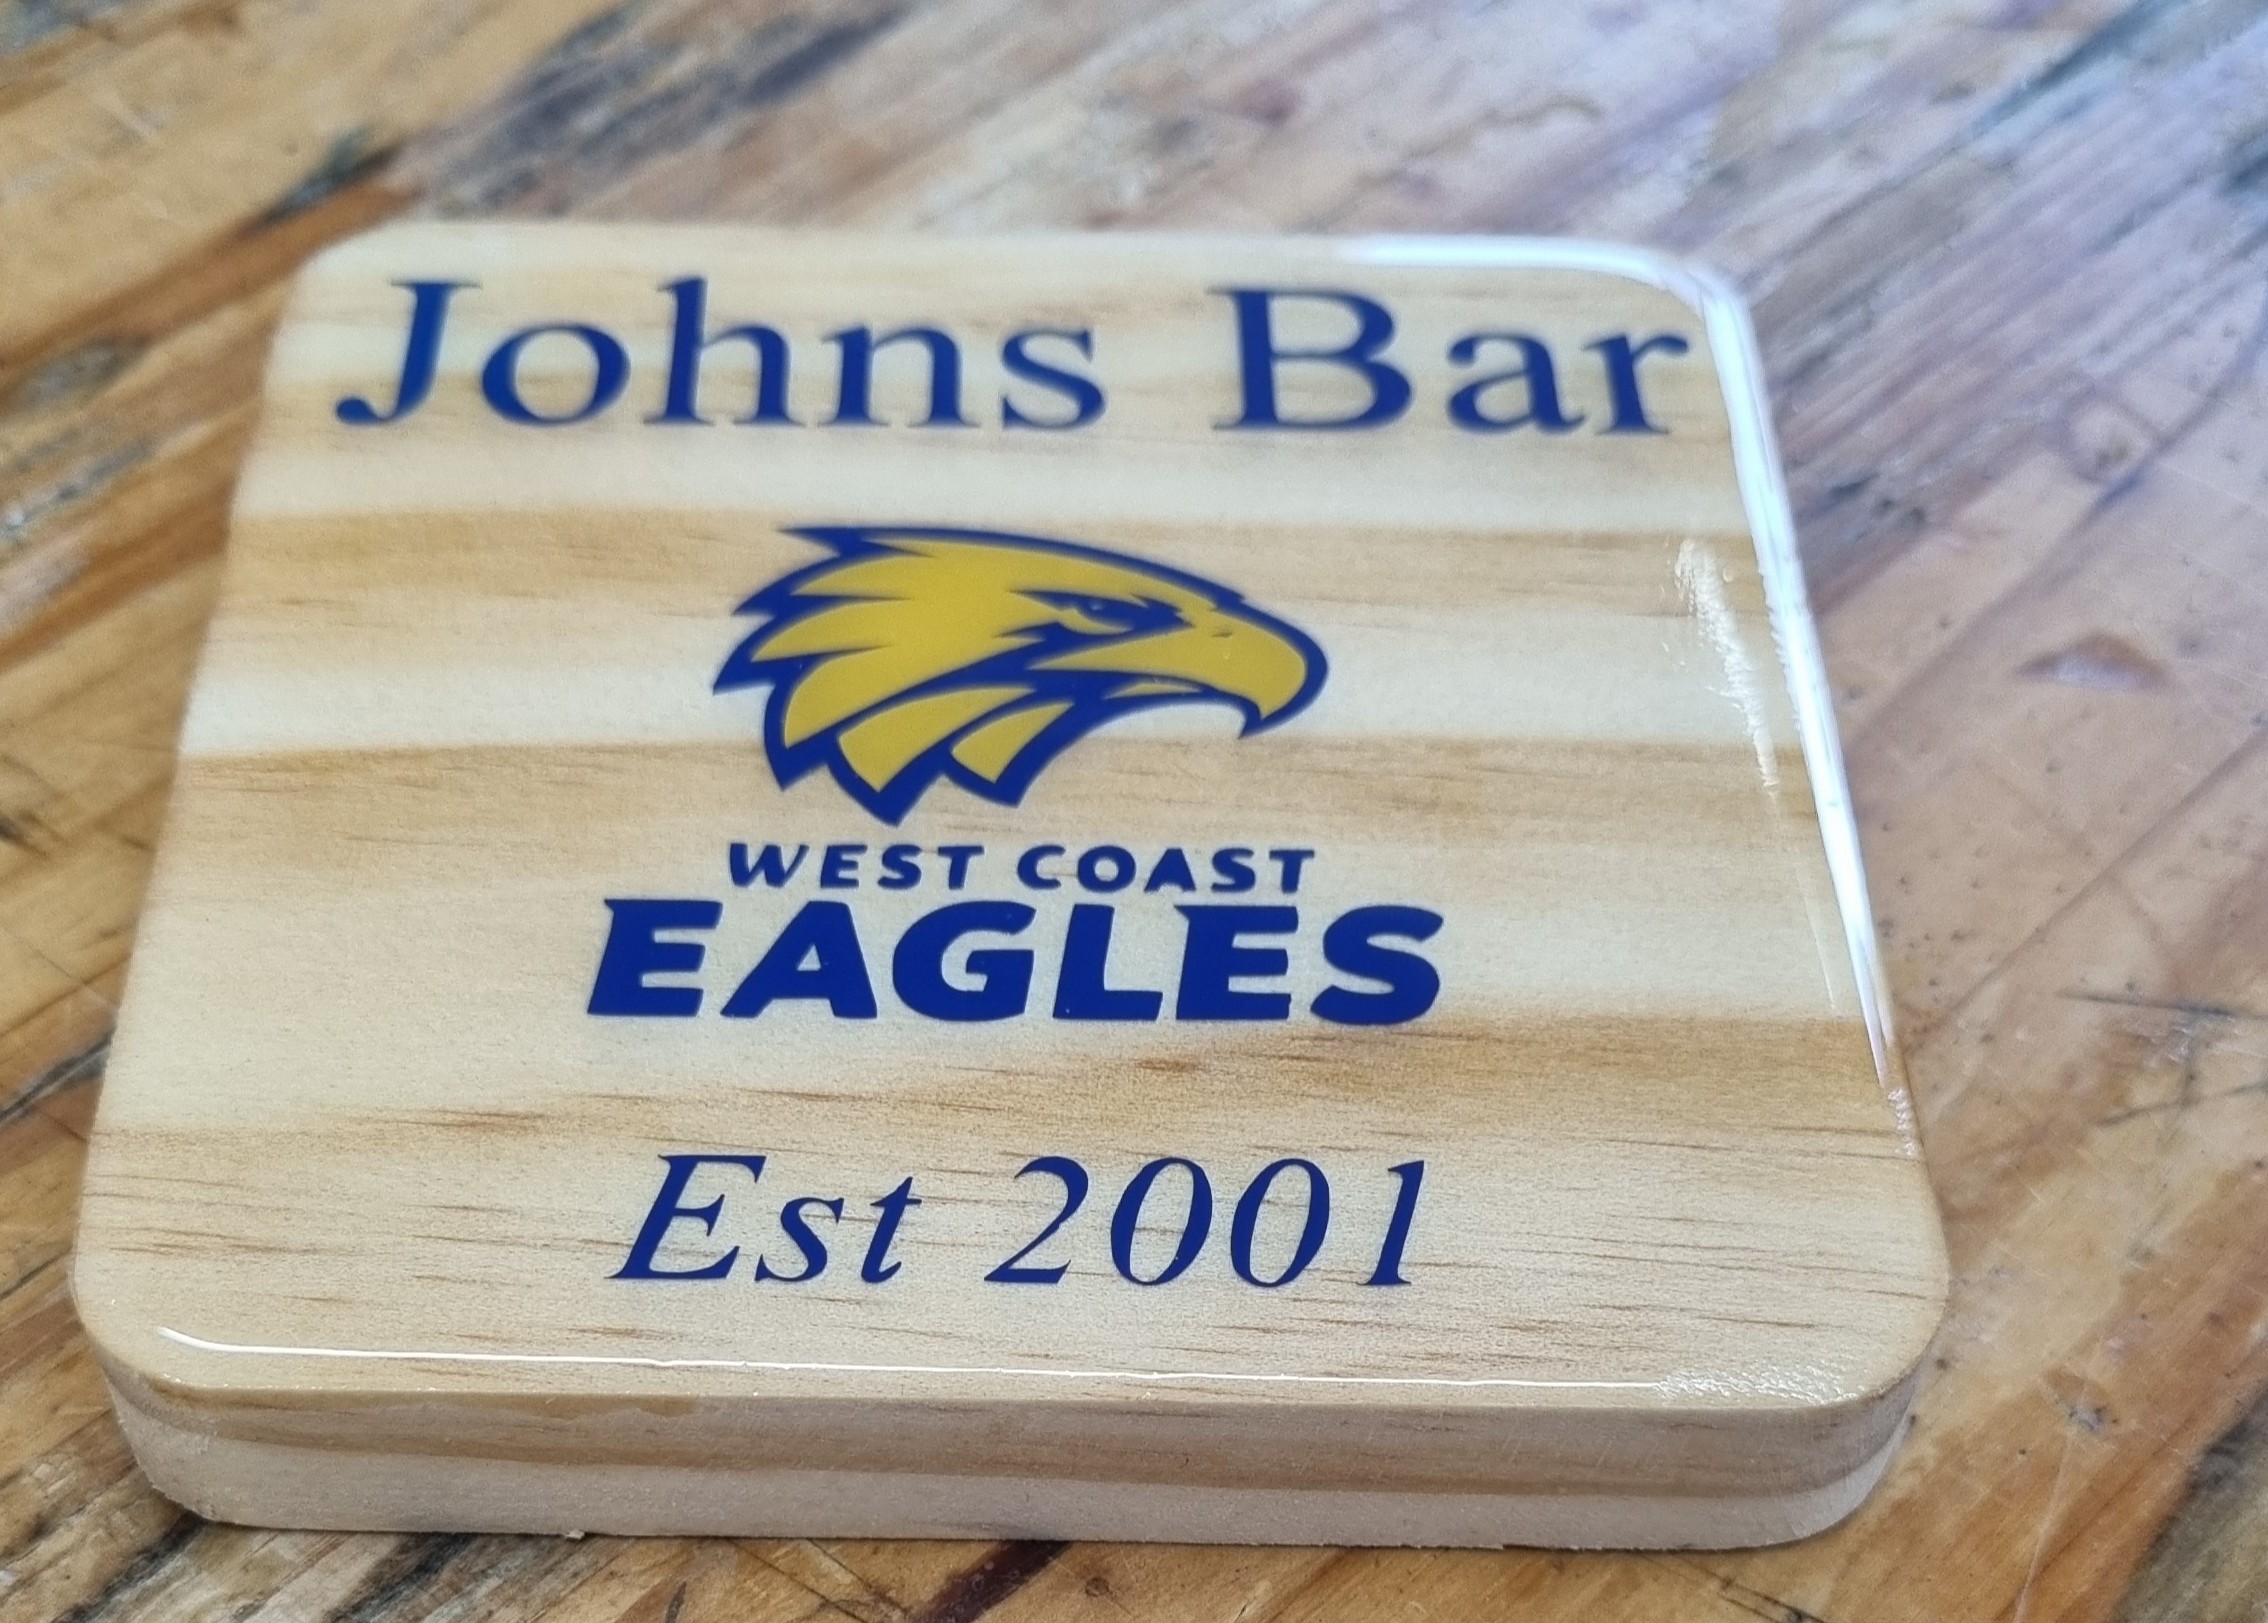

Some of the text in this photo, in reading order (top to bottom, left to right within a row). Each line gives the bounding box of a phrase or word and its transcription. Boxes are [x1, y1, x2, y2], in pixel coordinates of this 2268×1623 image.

[334, 275, 1690, 436] Johns Bar
[728, 842, 1315, 894] WEST COAST
[586, 897, 1444, 1028] EAGLES
[609, 1153, 1426, 1289] Est 2001
